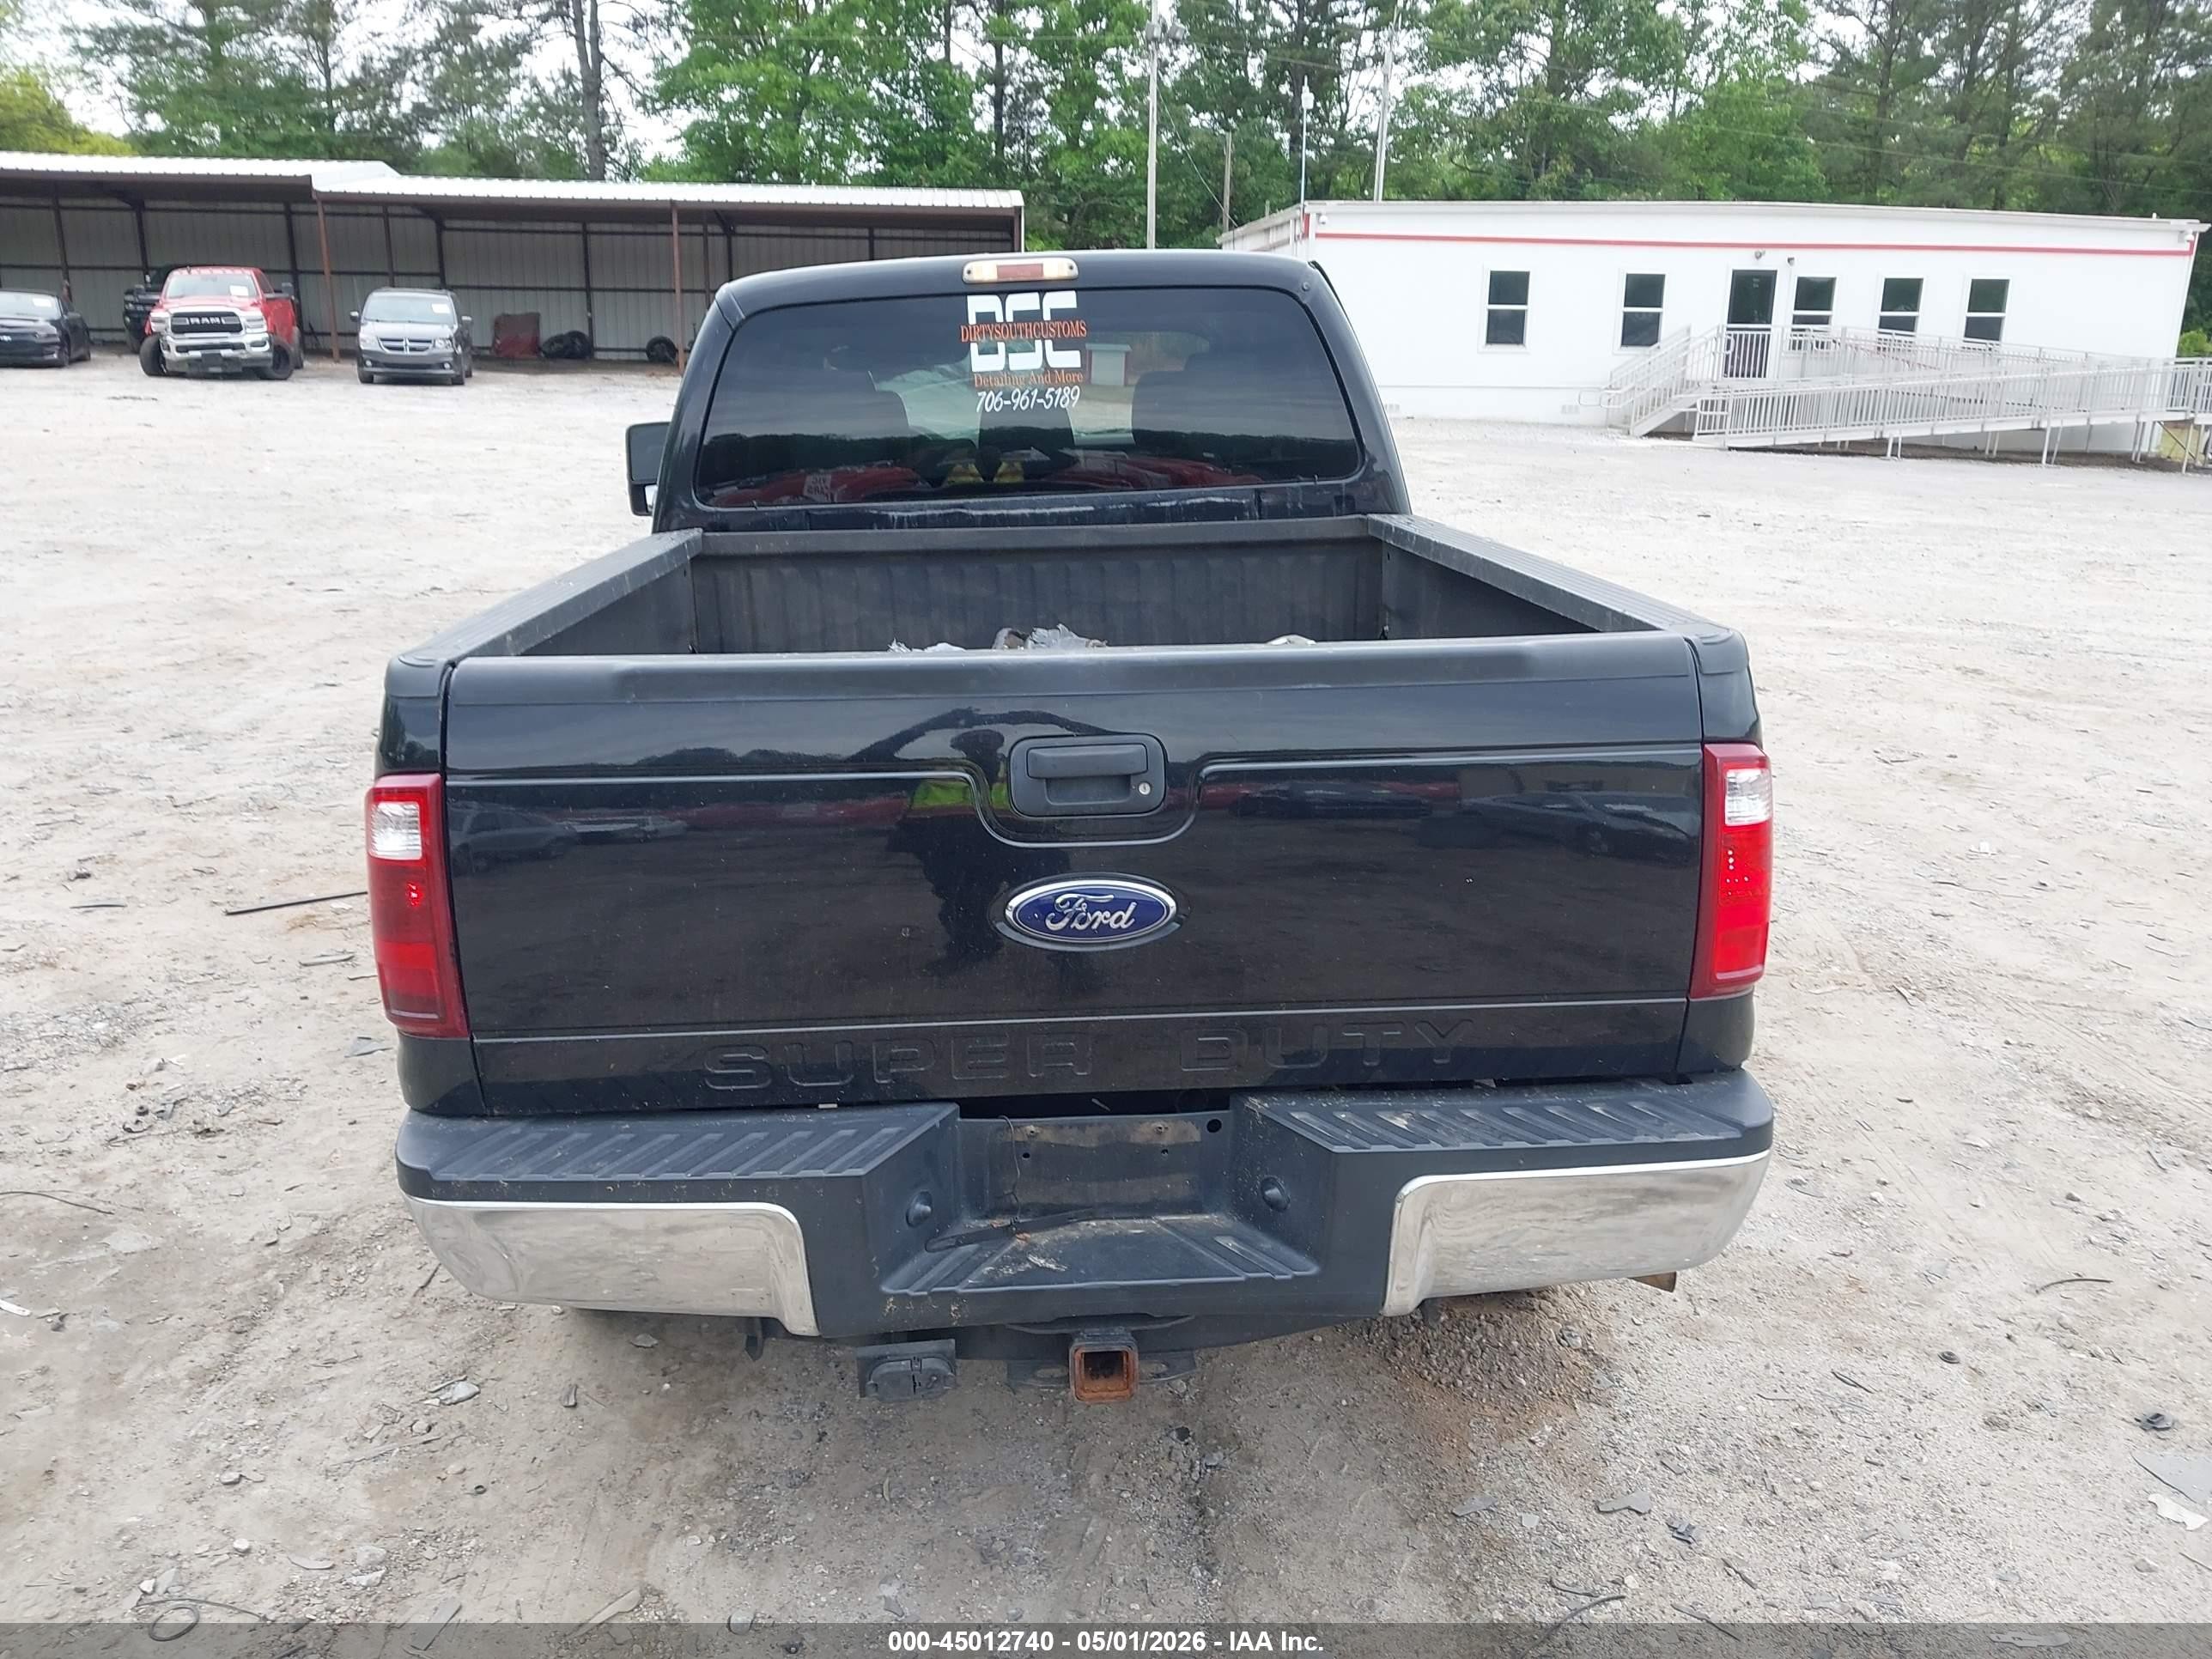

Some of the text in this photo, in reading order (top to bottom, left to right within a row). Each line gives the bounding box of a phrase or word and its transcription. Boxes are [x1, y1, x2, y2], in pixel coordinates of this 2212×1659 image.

[961, 320, 1086, 343] DIRTYSOUTHCUSTOMS
[974, 368, 1084, 388] Detailing And More
[975, 386, 1080, 412] 706-961-5189
[1045, 893, 1137, 931] Ford
[703, 1018, 1475, 1091] SUPER DUTY
